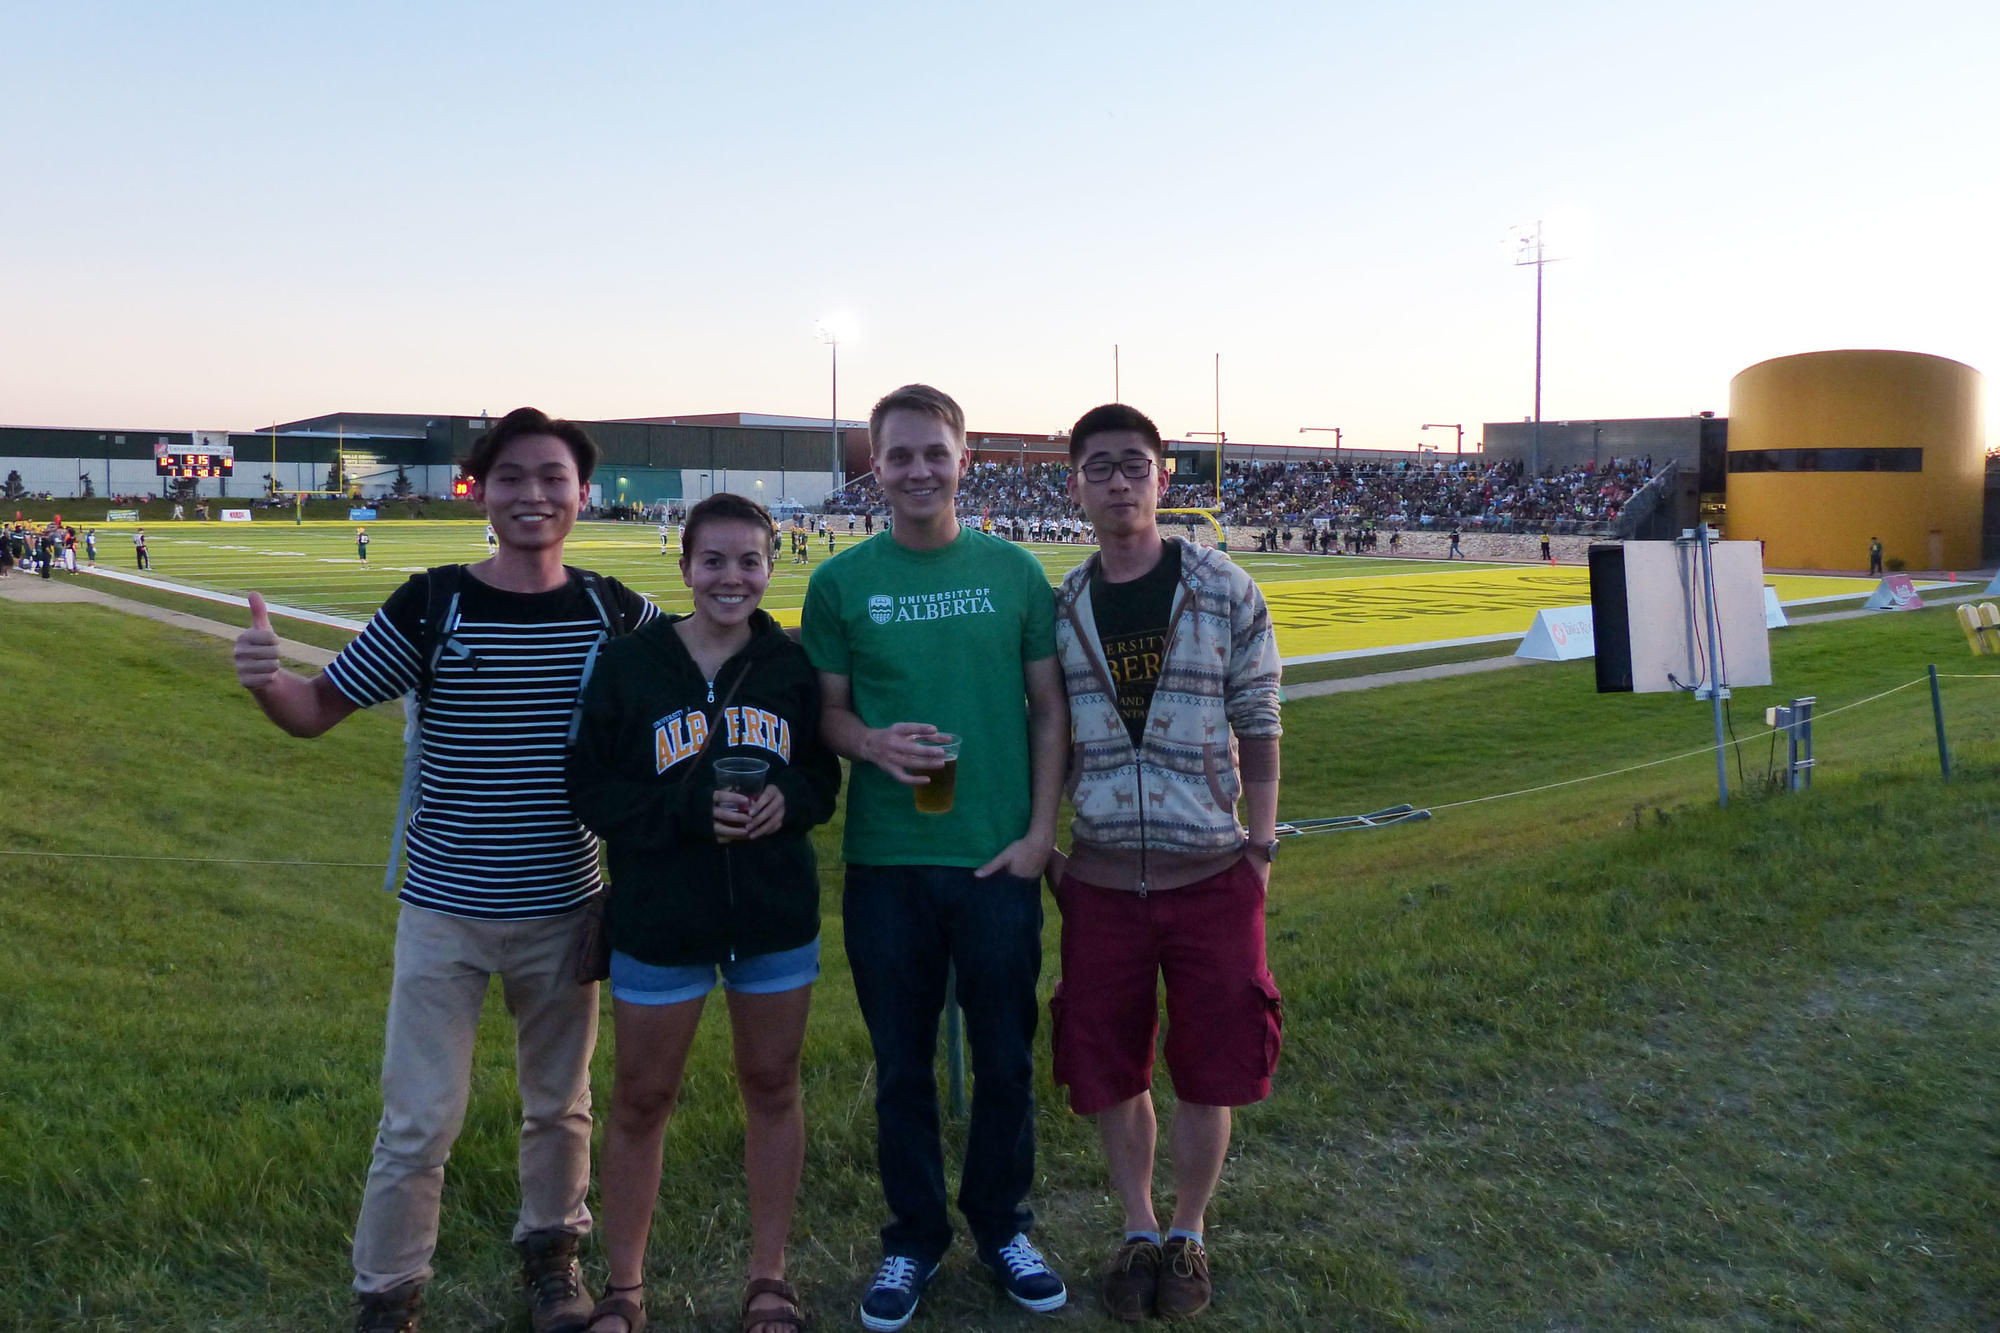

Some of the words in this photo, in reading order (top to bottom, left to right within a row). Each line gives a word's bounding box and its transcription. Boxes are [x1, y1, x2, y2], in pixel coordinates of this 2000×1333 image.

[899, 589, 971, 604] UNIVERSITY
[975, 588, 990, 596] OF
[895, 597, 996, 622] ALBERTA
[1106, 636, 1167, 655] ERSIT
[655, 705, 791, 775] ALBERTA
